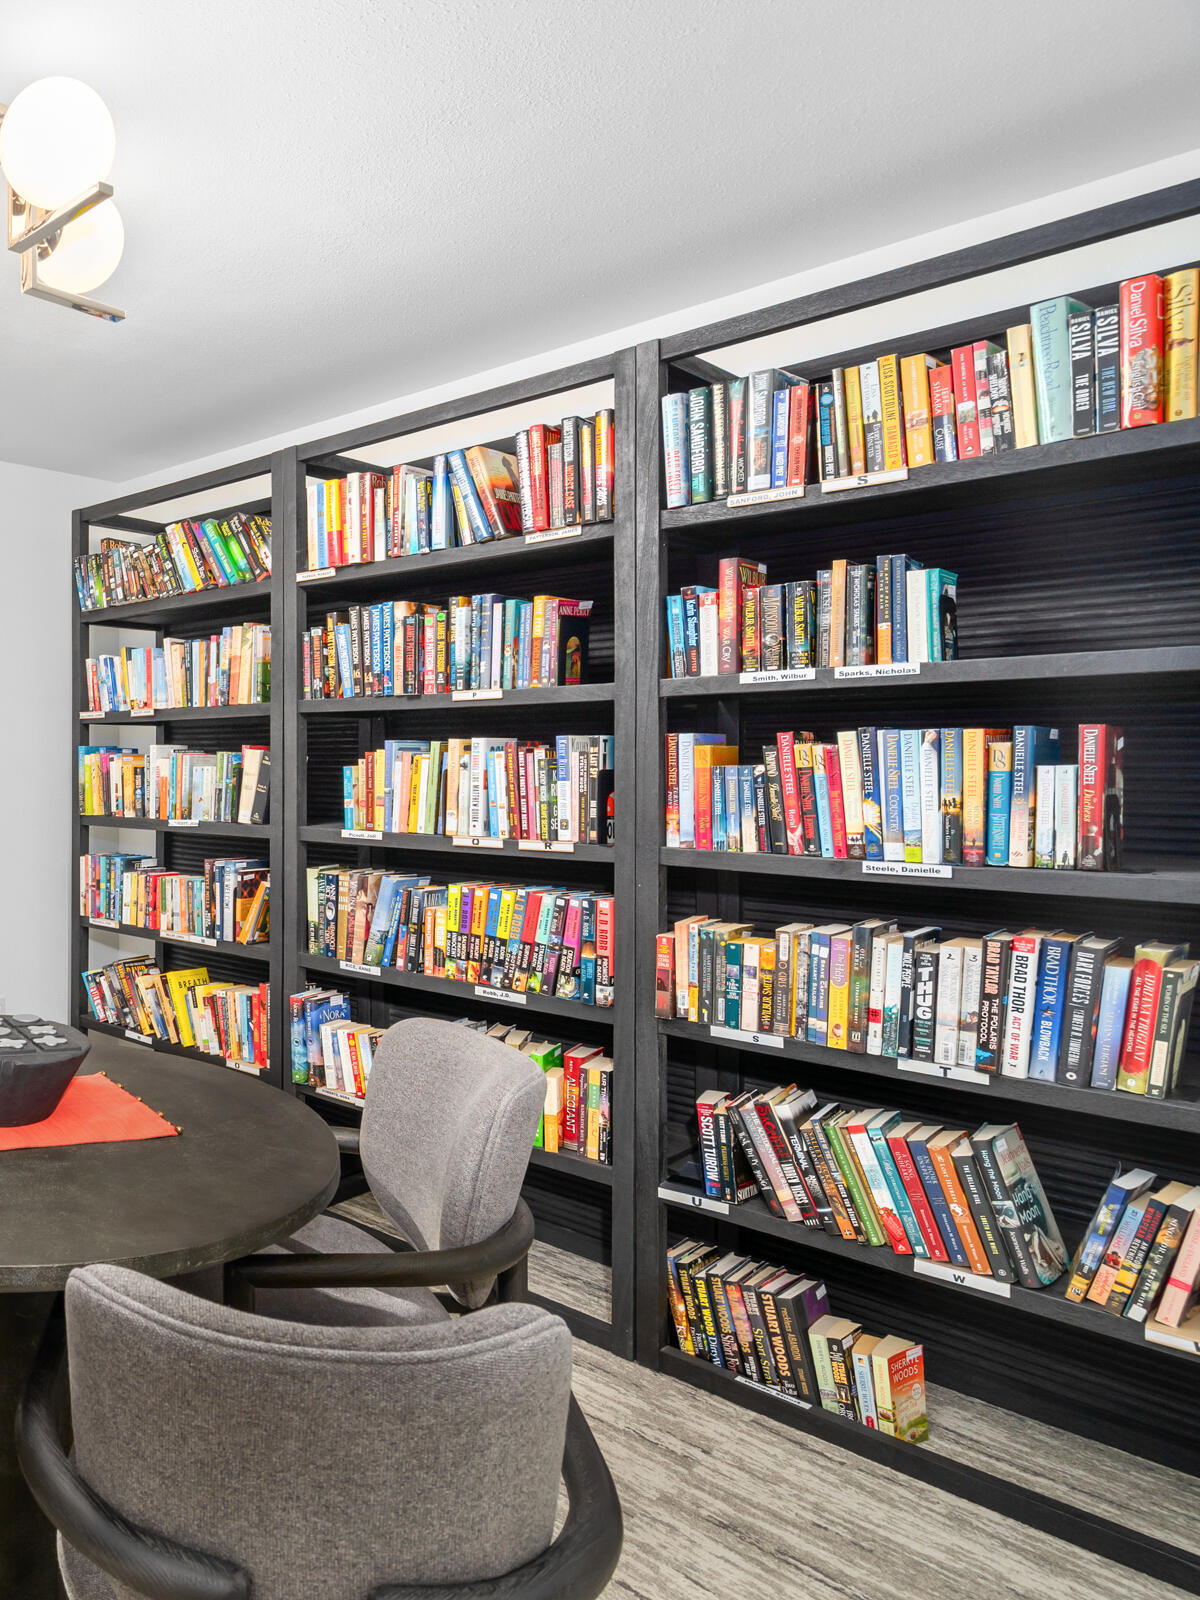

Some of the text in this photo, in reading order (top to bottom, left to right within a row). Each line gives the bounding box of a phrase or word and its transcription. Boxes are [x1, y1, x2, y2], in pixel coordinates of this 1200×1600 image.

[1129, 281, 1148, 348] Daniel Silva
[1070, 322, 1091, 361] SILVA
[1096, 316, 1119, 357] SILVA
[882, 362, 898, 463] LISA SCOTTOLINE DAMAGED
[932, 381, 940, 415] SHAARA
[690, 394, 705, 474] JOHN SANDFORD
[564, 465, 574, 509] WORST CASE
[730, 489, 798, 506] SANFORD, JOHN
[857, 476, 868, 485] S
[686, 600, 698, 647] Karin Slaughter
[794, 595, 804, 645] WILBUR SMITH
[372, 631, 381, 673] PATTERSON
[354, 670, 360, 678] 16
[364, 673, 373, 682] 14
[780, 735, 794, 795] DANIELLE STEEL
[861, 733, 873, 794] DANIELLE STEEL
[1014, 729, 1025, 795] DANIELLE STEEL
[1083, 729, 1098, 785] DANIELLE STEEL
[865, 865, 899, 873] Steele,
[984, 941, 1001, 995] BRAD TAYLOR
[322, 1009, 347, 1020] NORA
[979, 1001, 989, 1044] PROTOCOL
[1008, 955, 1029, 1061] BRAD THOR ACT OF WAR
[1038, 945, 1061, 1062] BRAD THOR BLOWBACK
[753, 1035, 759, 1043] S
[939, 1066, 951, 1078] T
[567, 1075, 576, 1134] ALLEGIANT
[701, 1115, 721, 1182] SCOTT TUROW
[789, 1134, 809, 1170] TERMINAL
[692, 1197, 702, 1206] U
[953, 1273, 965, 1283] W
[761, 1293, 790, 1377] STUART WOODS
[892, 1366, 919, 1383] WOODS
